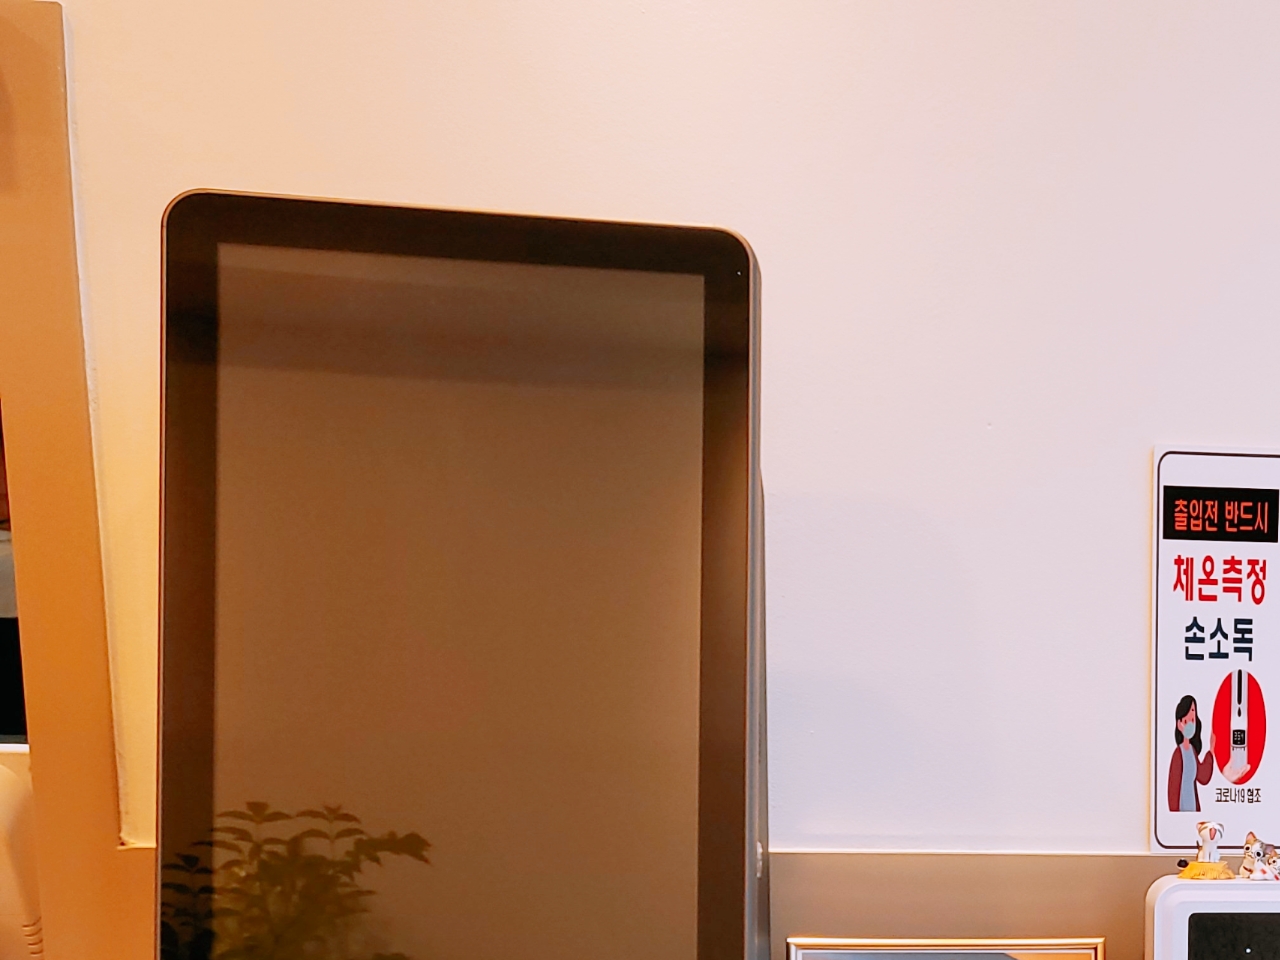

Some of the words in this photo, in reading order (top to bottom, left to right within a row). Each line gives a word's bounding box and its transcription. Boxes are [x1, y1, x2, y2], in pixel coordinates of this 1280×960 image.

[1174, 499, 1219, 533] 출입전
[1225, 501, 1268, 534] 반드시
[1173, 555, 1267, 605] 체온측정
[1184, 617, 1254, 661] 손소독
[1215, 788, 1245, 804] 코로나19
[1247, 788, 1261, 803] 협조
